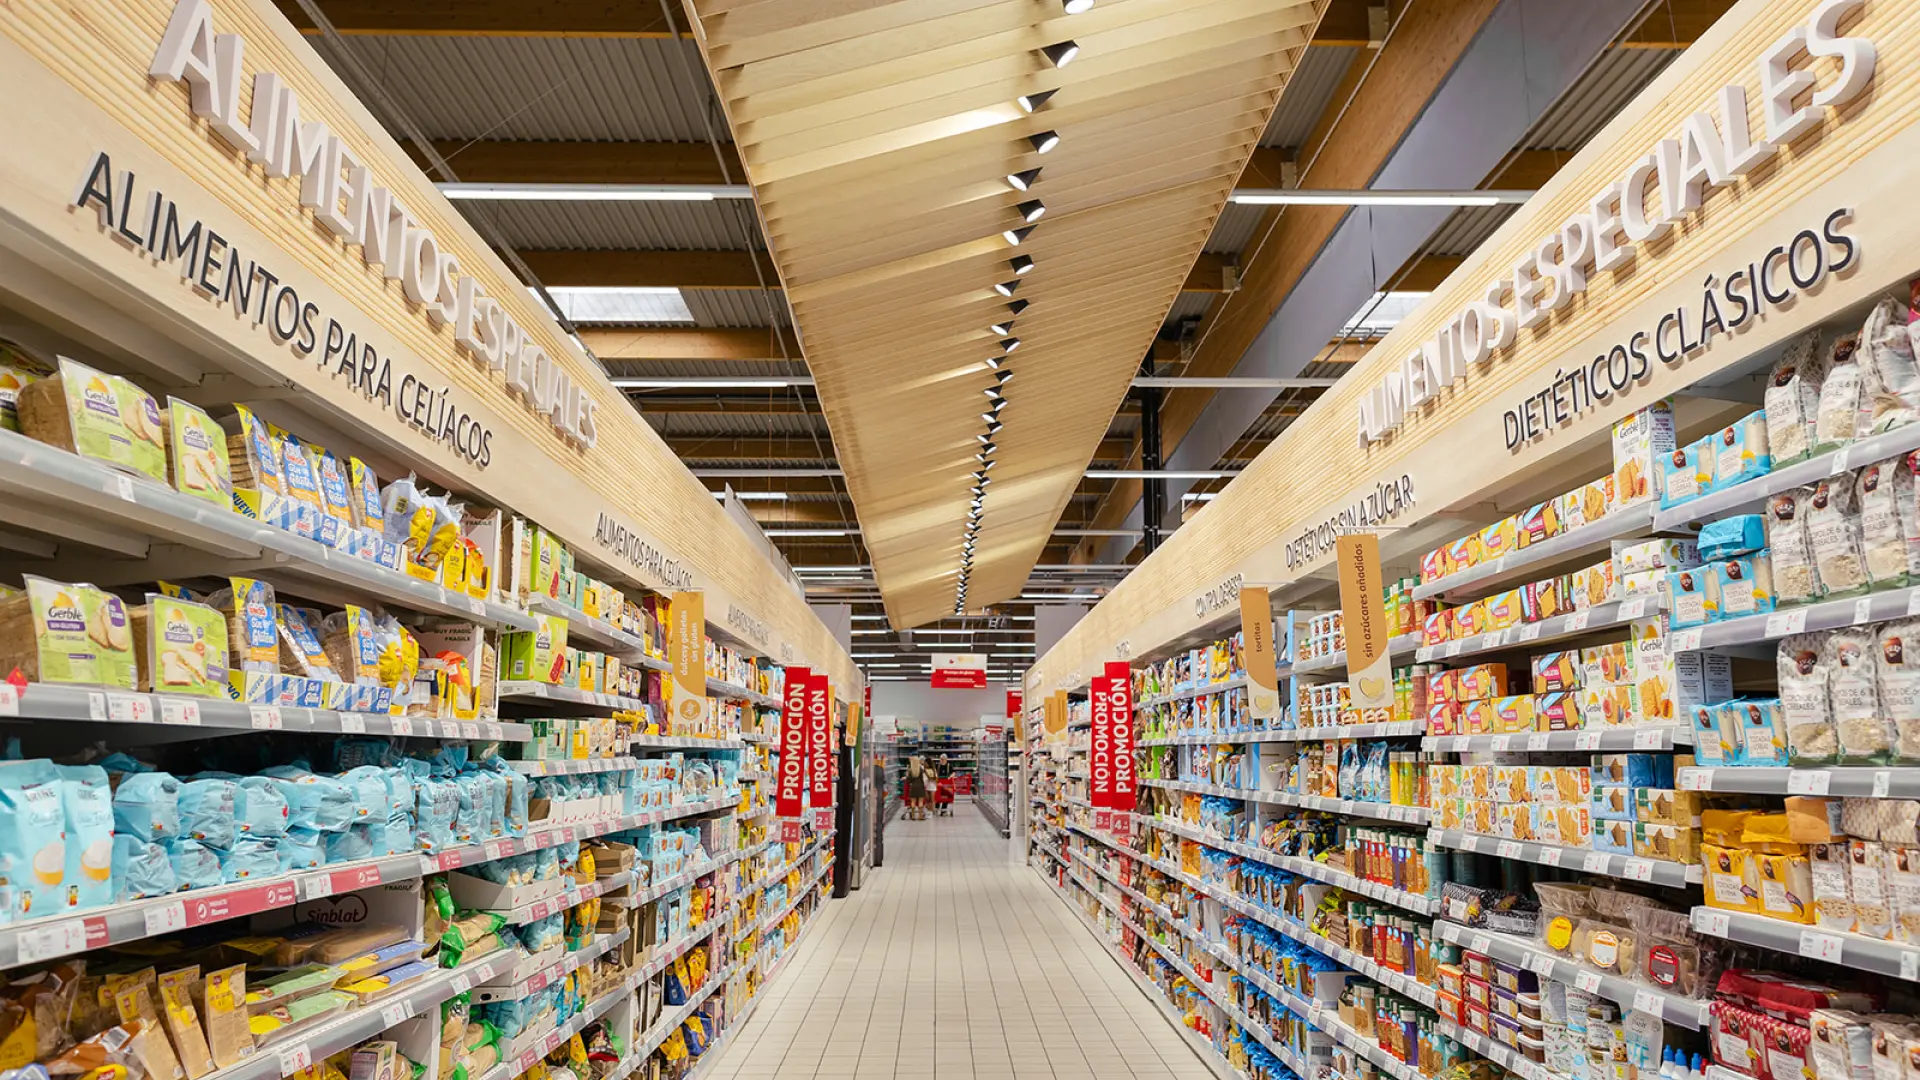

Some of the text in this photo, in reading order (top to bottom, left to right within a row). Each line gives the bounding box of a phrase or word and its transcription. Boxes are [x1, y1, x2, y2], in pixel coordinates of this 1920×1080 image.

[150, 0, 597, 450] ALIMENTOS ESPECIALES
[1356, 0, 1877, 450] ALIMENTOS ESPECIALES
[76, 151, 493, 468] ALIMENTOS PARA CELÍACOS
[1503, 208, 1854, 451] DIETÉTICOS CLÁSICOS
[594, 512, 645, 568] ALIMENTOS
[1285, 516, 1337, 569] DIETÉTICOS
[1359, 474, 1413, 527] AZÚCAR
[1354, 543, 1373, 658] sin azúcares añadidos
[782, 683, 805, 800] PROMOCIÓN
[808, 690, 828, 793] PROMOCIÓN
[1095, 692, 1110, 792] PROMOCIÓN
[1108, 678, 1131, 793] PROMOCIÓN
[307, 907, 359, 923] Sinblat
